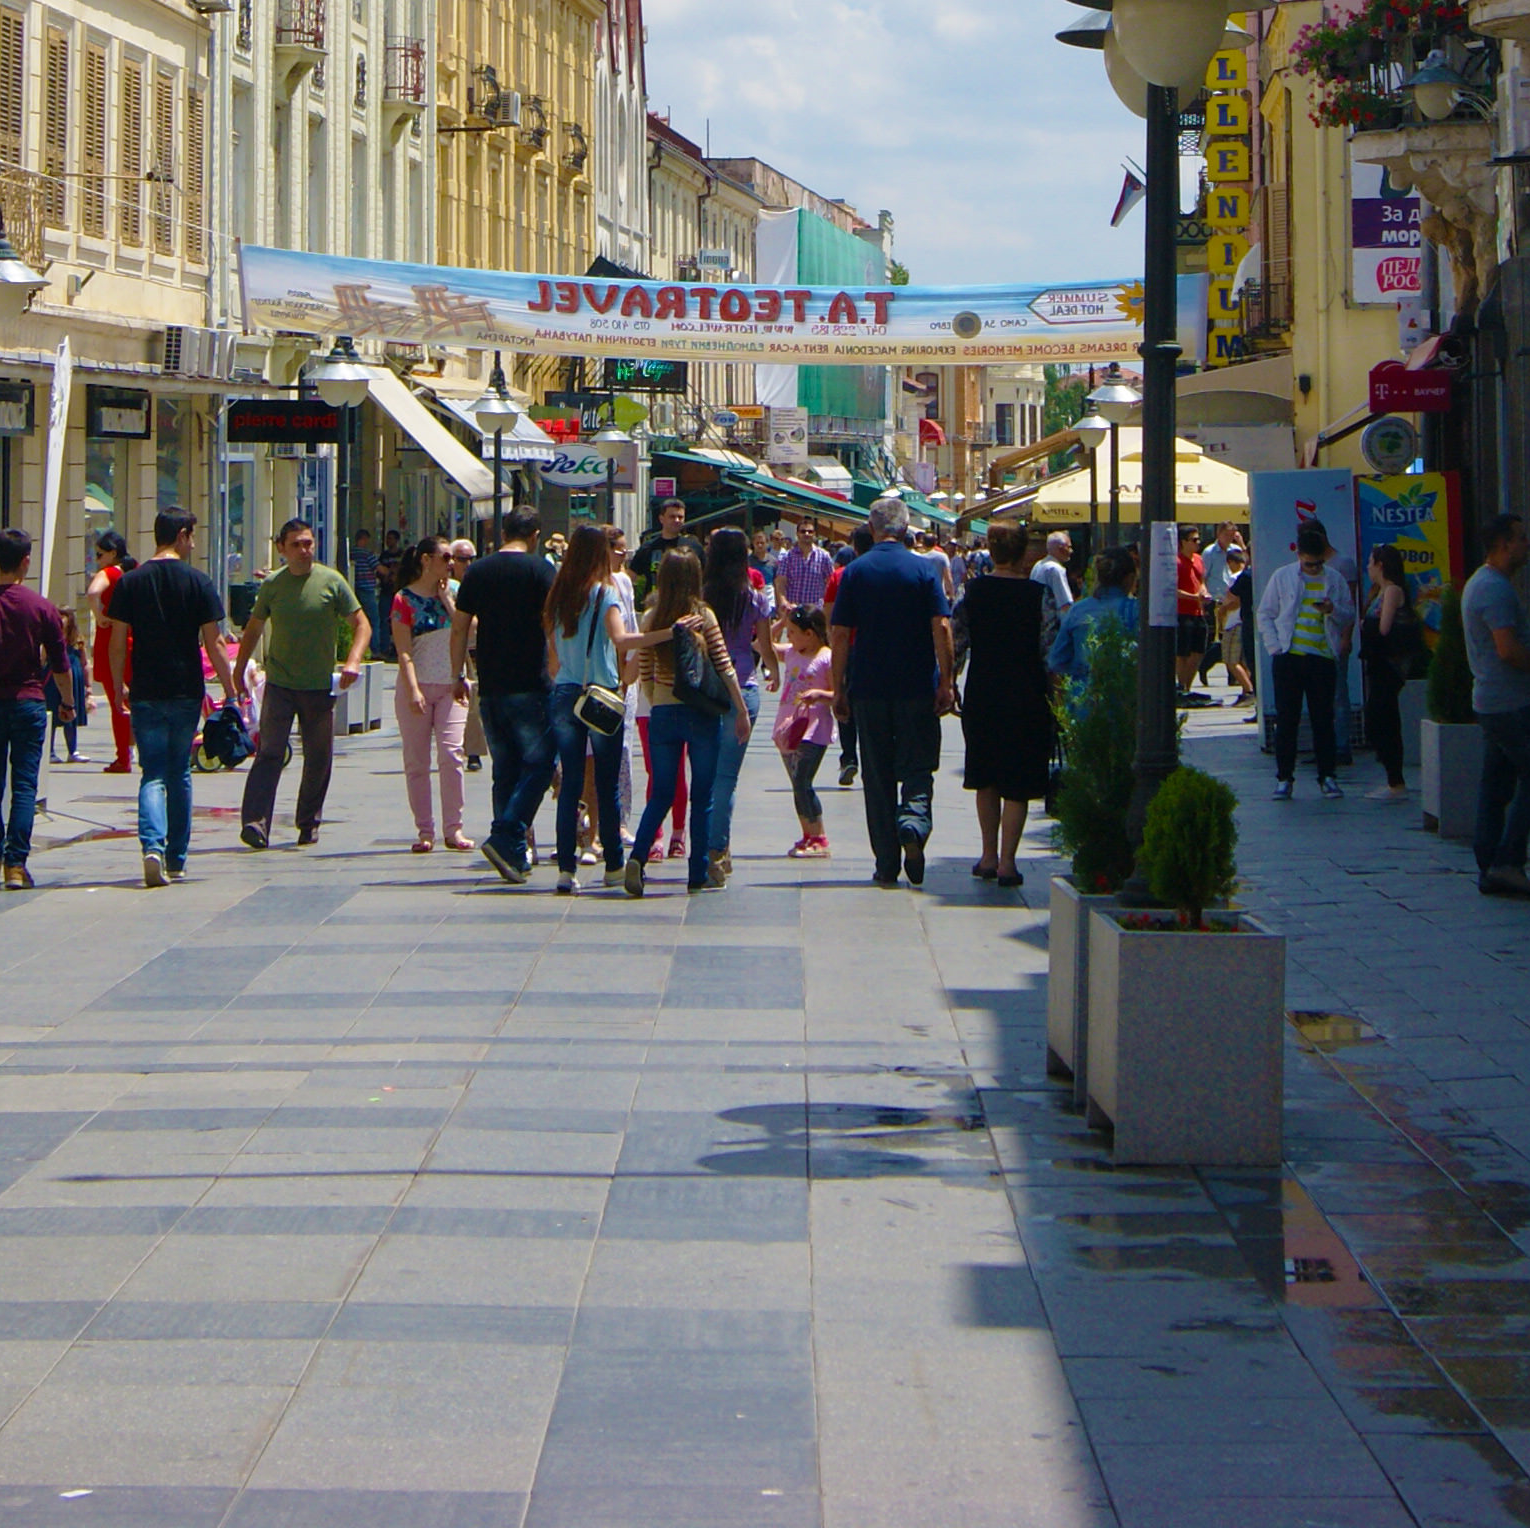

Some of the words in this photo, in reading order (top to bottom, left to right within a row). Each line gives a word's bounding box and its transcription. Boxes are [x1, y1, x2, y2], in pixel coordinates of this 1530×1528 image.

[1215, 57, 1246, 359] LLENIUM
[1382, 205, 1403, 223] За
[1382, 229, 1421, 247] мор
[1382, 260, 1421, 271] ПЕЛ
[1383, 274, 1421, 289] РОС
[234, 413, 287, 430] pierre
[291, 413, 338, 429] cardi
[1372, 506, 1436, 523] NESTEA
